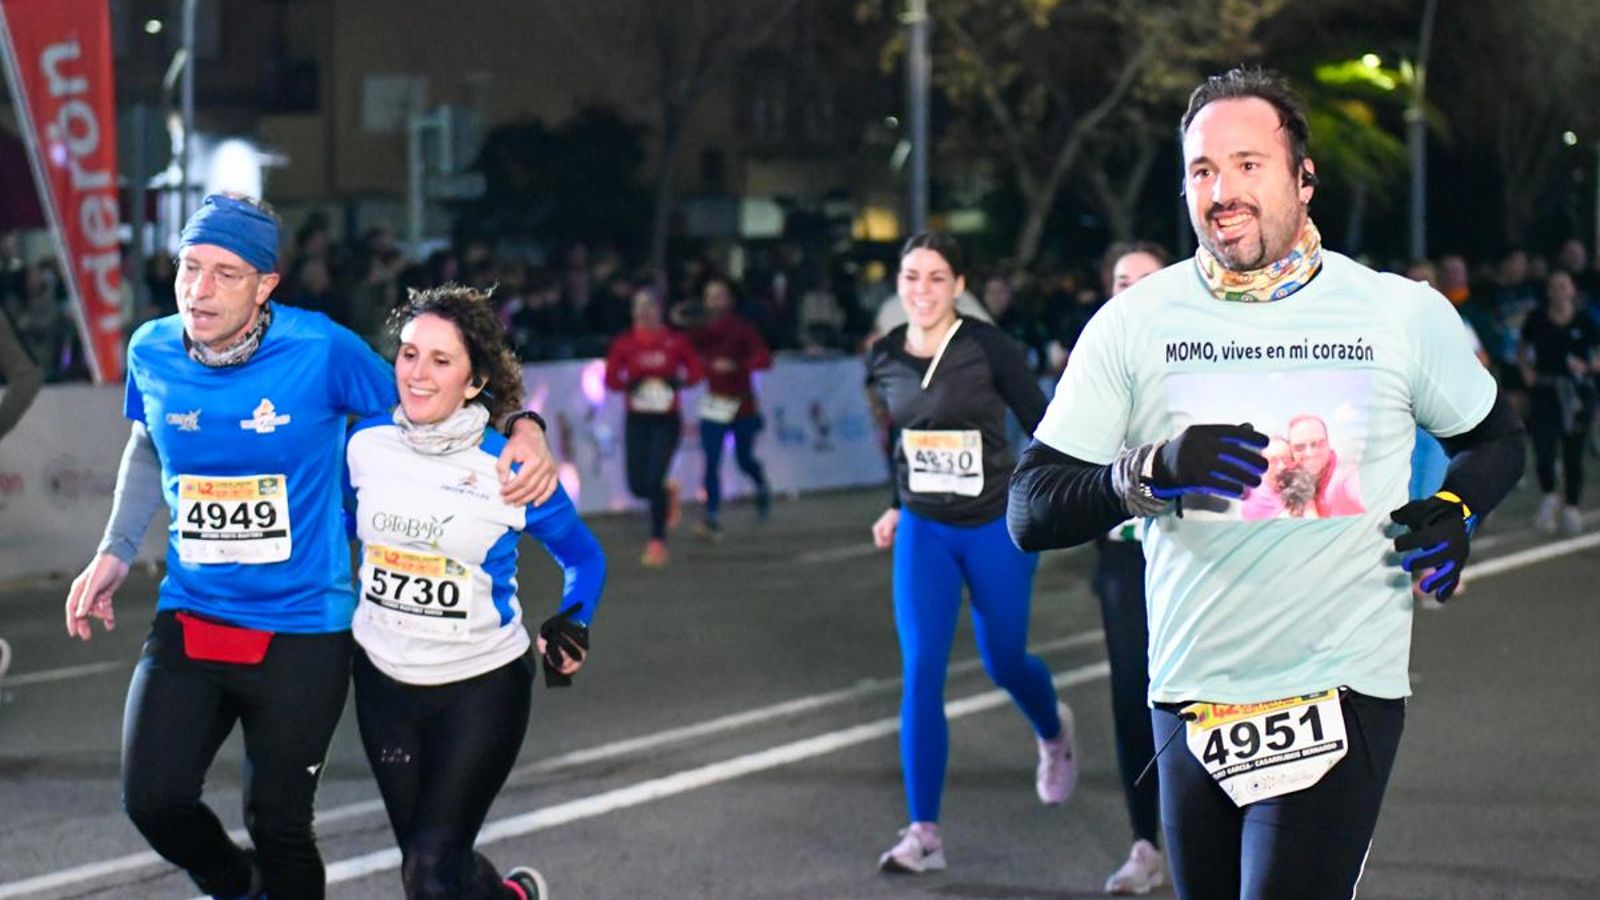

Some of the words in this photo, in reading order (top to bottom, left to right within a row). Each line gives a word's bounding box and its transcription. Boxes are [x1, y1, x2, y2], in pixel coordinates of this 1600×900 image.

[40, 39, 122, 345] lderón
[1166, 341, 1218, 363] MOMO,
[1222, 341, 1262, 360] vives
[1267, 345, 1285, 359] en
[1290, 338, 1308, 359] mi
[1312, 337, 1374, 361] corazón
[187, 501, 277, 530] 4949
[371, 567, 460, 608] 5730
[1203, 704, 1325, 766] 4951
